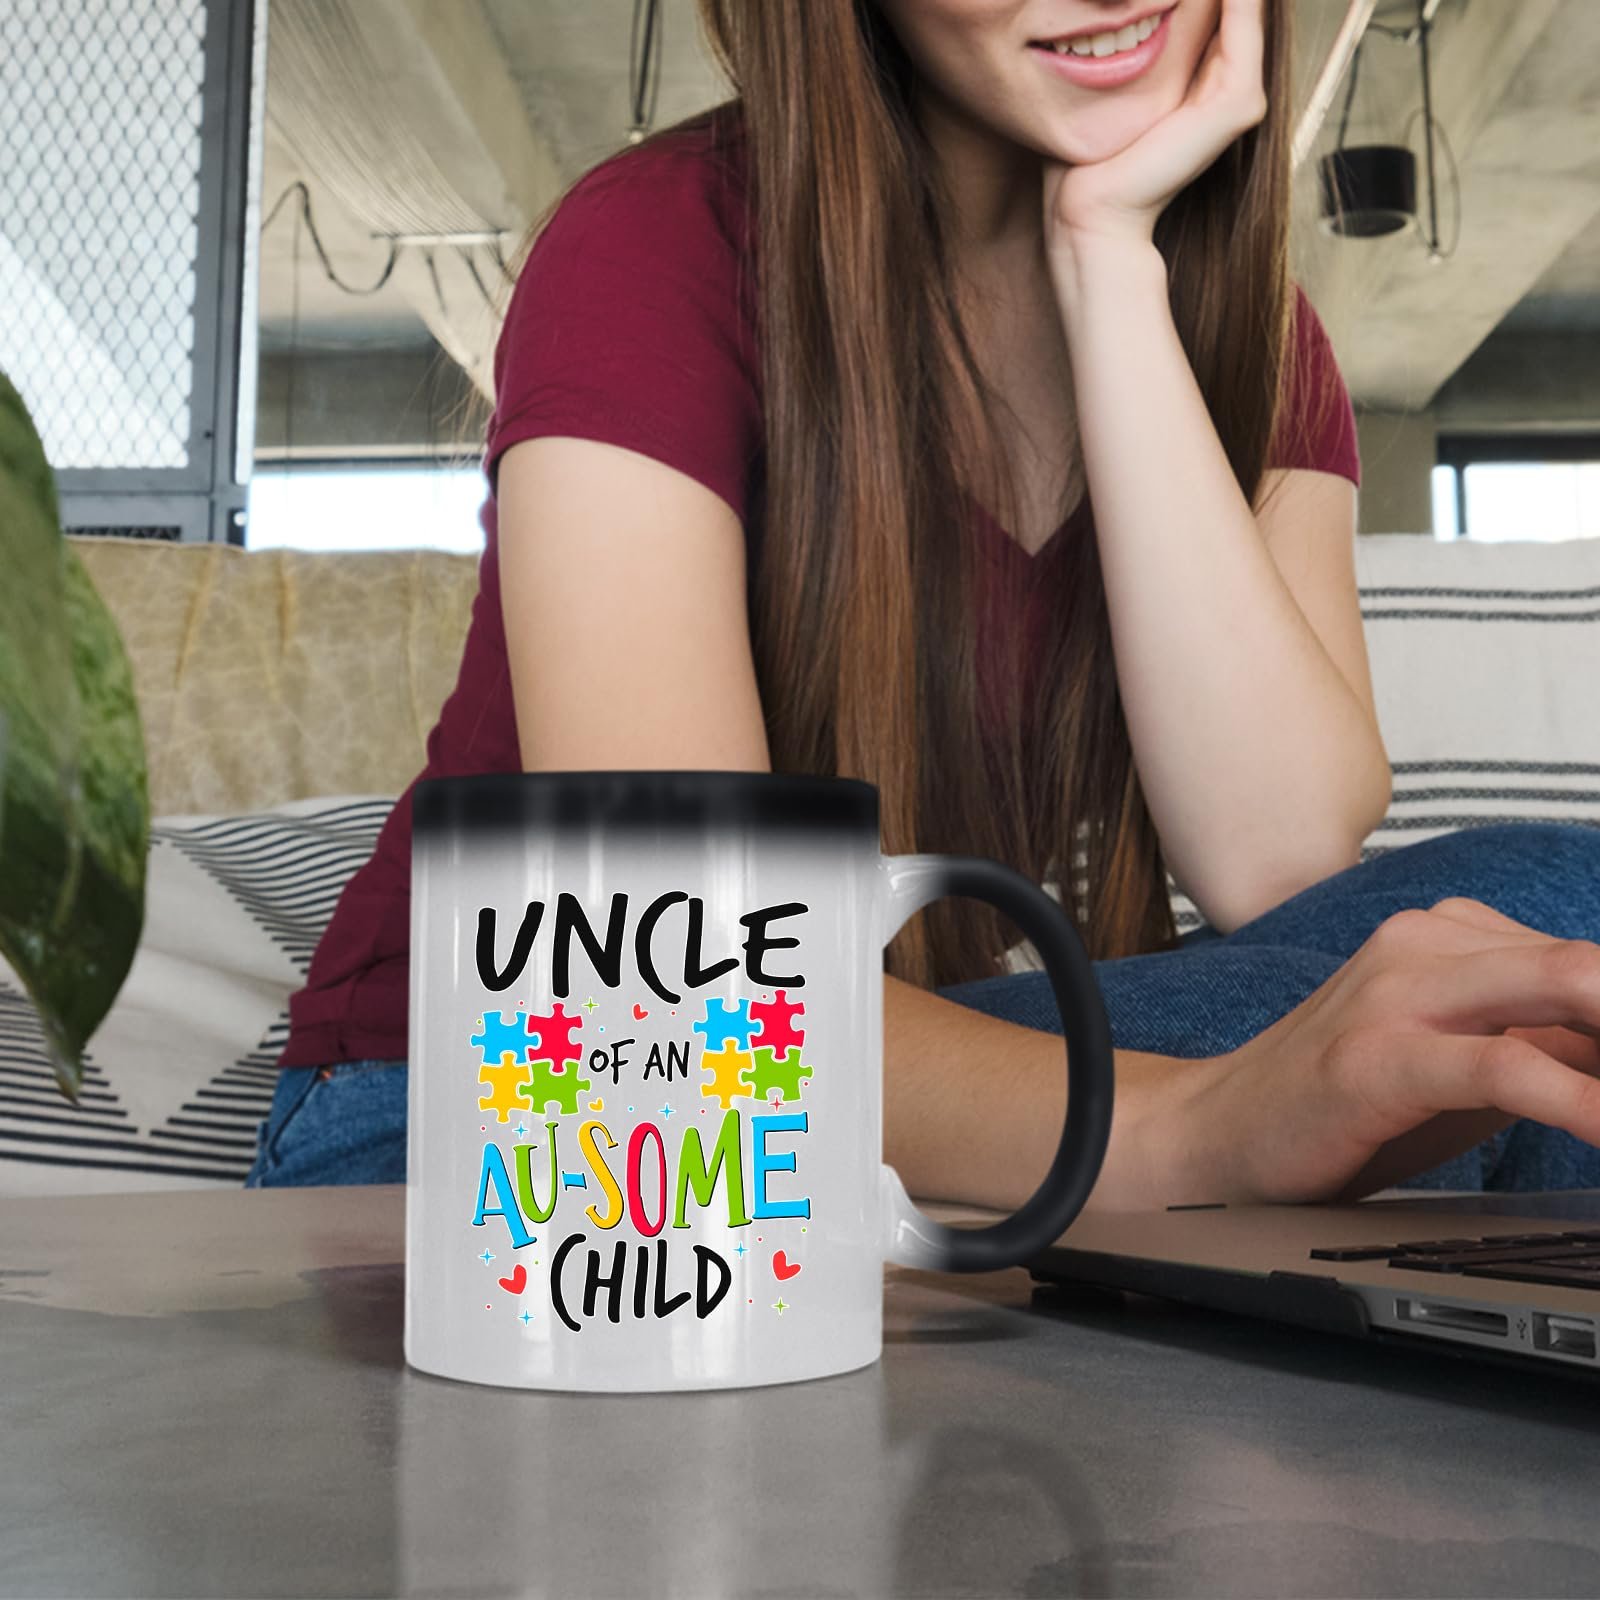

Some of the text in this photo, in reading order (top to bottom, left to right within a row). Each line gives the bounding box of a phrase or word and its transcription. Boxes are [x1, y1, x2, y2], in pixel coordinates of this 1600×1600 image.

[476, 892, 809, 1004] UNCLE
[589, 1039, 691, 1084] OF AN
[472, 1109, 811, 1249] AU-SOME
[550, 1234, 732, 1332] CHILD
